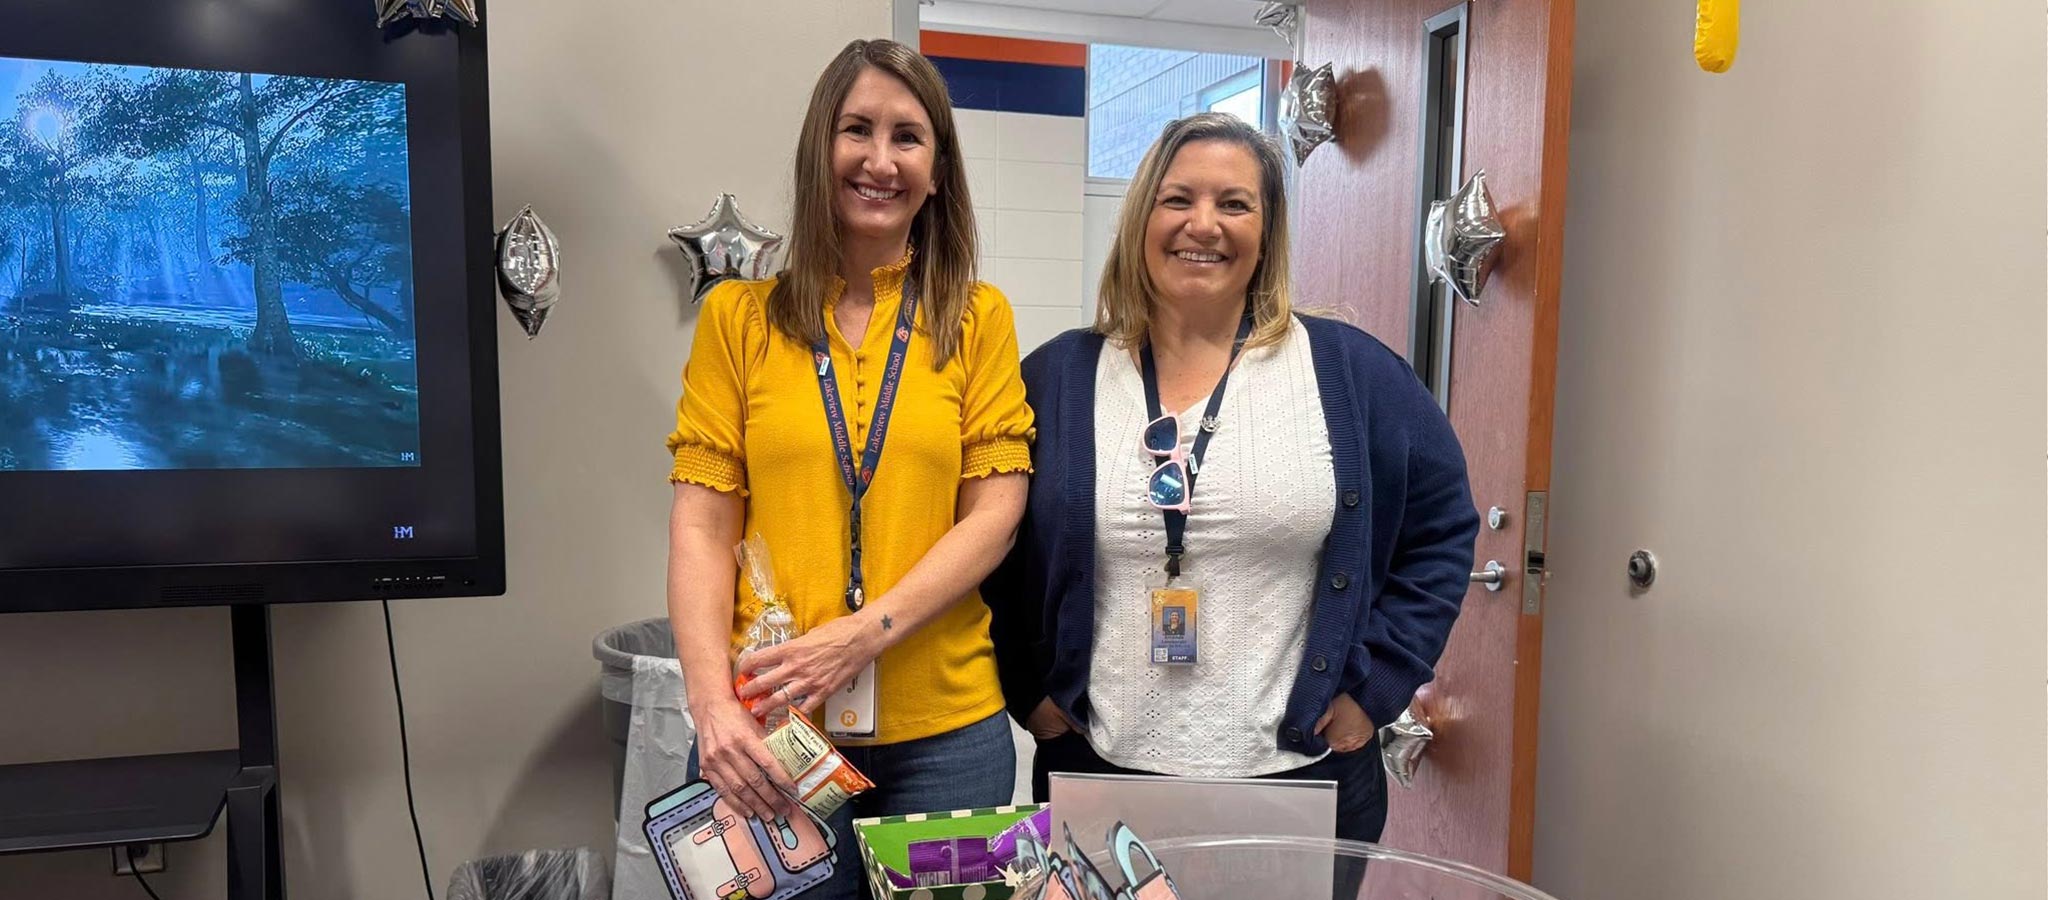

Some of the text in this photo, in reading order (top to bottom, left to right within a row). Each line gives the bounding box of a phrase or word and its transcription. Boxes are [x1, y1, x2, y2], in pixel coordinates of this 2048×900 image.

[823, 378, 838, 418] Lakeview
[832, 421, 848, 453] Middle
[841, 454, 855, 485] School
[870, 352, 902, 453] Lakeview Middle School
